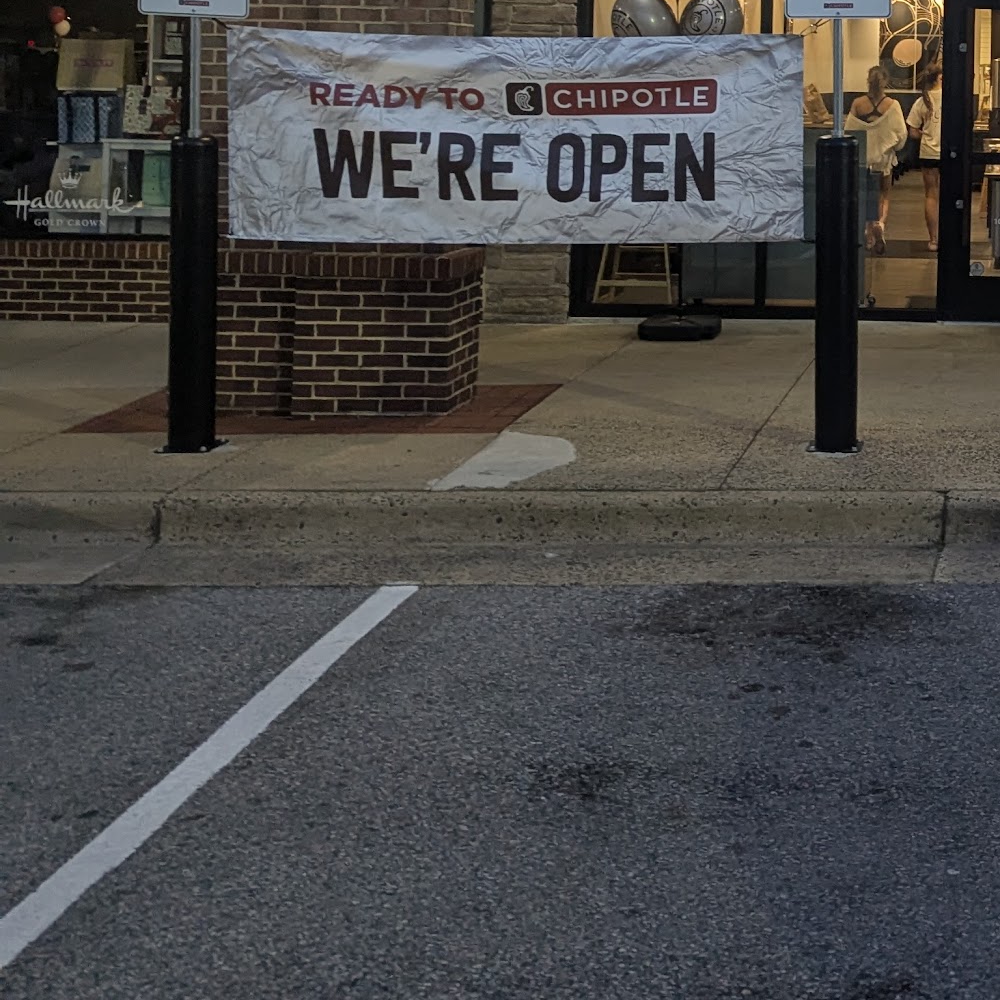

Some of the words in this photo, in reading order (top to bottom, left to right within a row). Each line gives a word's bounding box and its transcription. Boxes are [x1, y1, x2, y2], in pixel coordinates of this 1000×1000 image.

[309, 82, 428, 109] READY
[438, 87, 485, 111] TO
[552, 85, 710, 110] CHIPOTLE
[314, 128, 521, 201] WE'RE
[546, 132, 715, 202] OPEN
[4, 184, 144, 221] Hallmark
[34, 218, 64, 227] GOLD
[67, 219, 106, 227] CROWN
